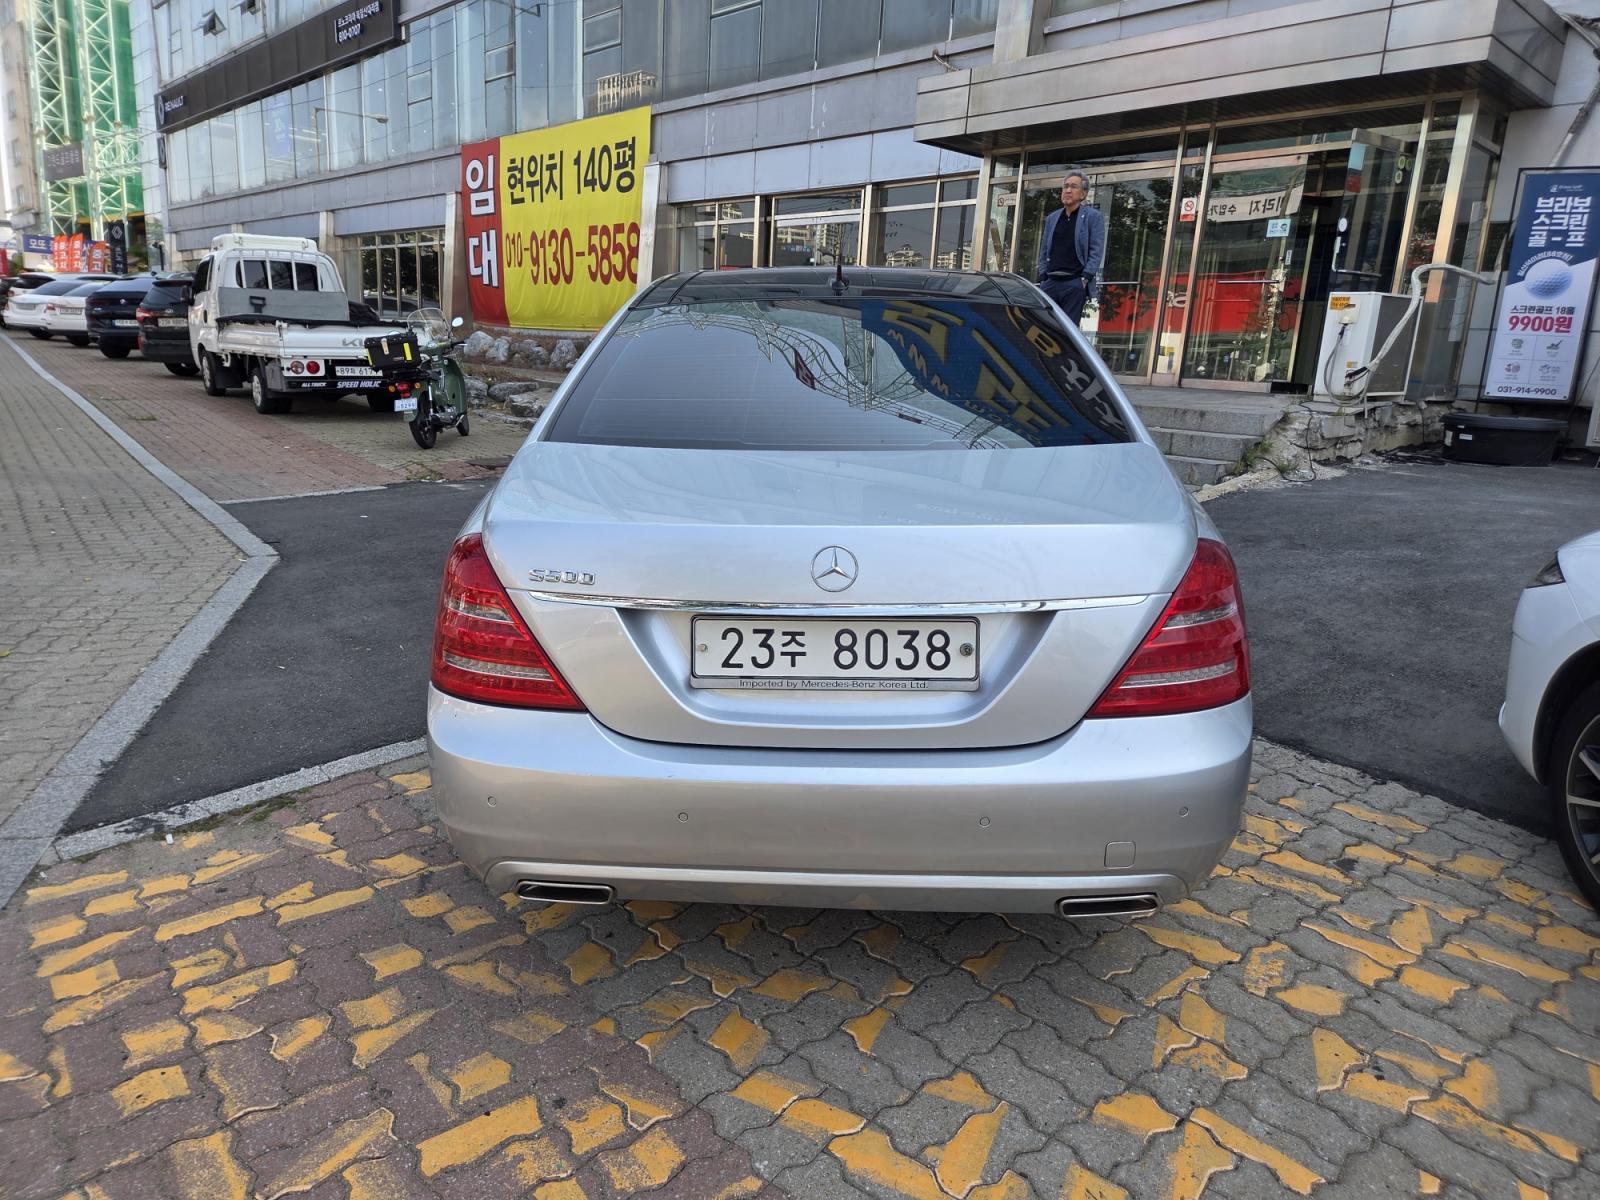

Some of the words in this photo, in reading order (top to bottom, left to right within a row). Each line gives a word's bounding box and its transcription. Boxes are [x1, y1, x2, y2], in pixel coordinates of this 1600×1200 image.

[506, 150, 564, 205] 현위치
[573, 136, 636, 194] 140평
[1534, 196, 1592, 213] 브라보
[1531, 214, 1589, 230] 스크린
[505, 221, 640, 286] 010-9130-5858
[1510, 305, 1554, 315] 스크린골프
[1508, 315, 1573, 333] 9900원
[342, 338, 364, 347] KI
[358, 367, 373, 375] 617
[1497, 385, 1557, 396] 031-914-9900
[529, 569, 595, 585] S500
[720, 627, 807, 669] 23주
[833, 628, 951, 671] 8038
[739, 679, 787, 689] Imported
[790, 679, 799, 689] by
[801, 679, 876, 688] Mercedes-Benz
[878, 680, 907, 689] Korea
[910, 680, 929, 689] Ltd.
